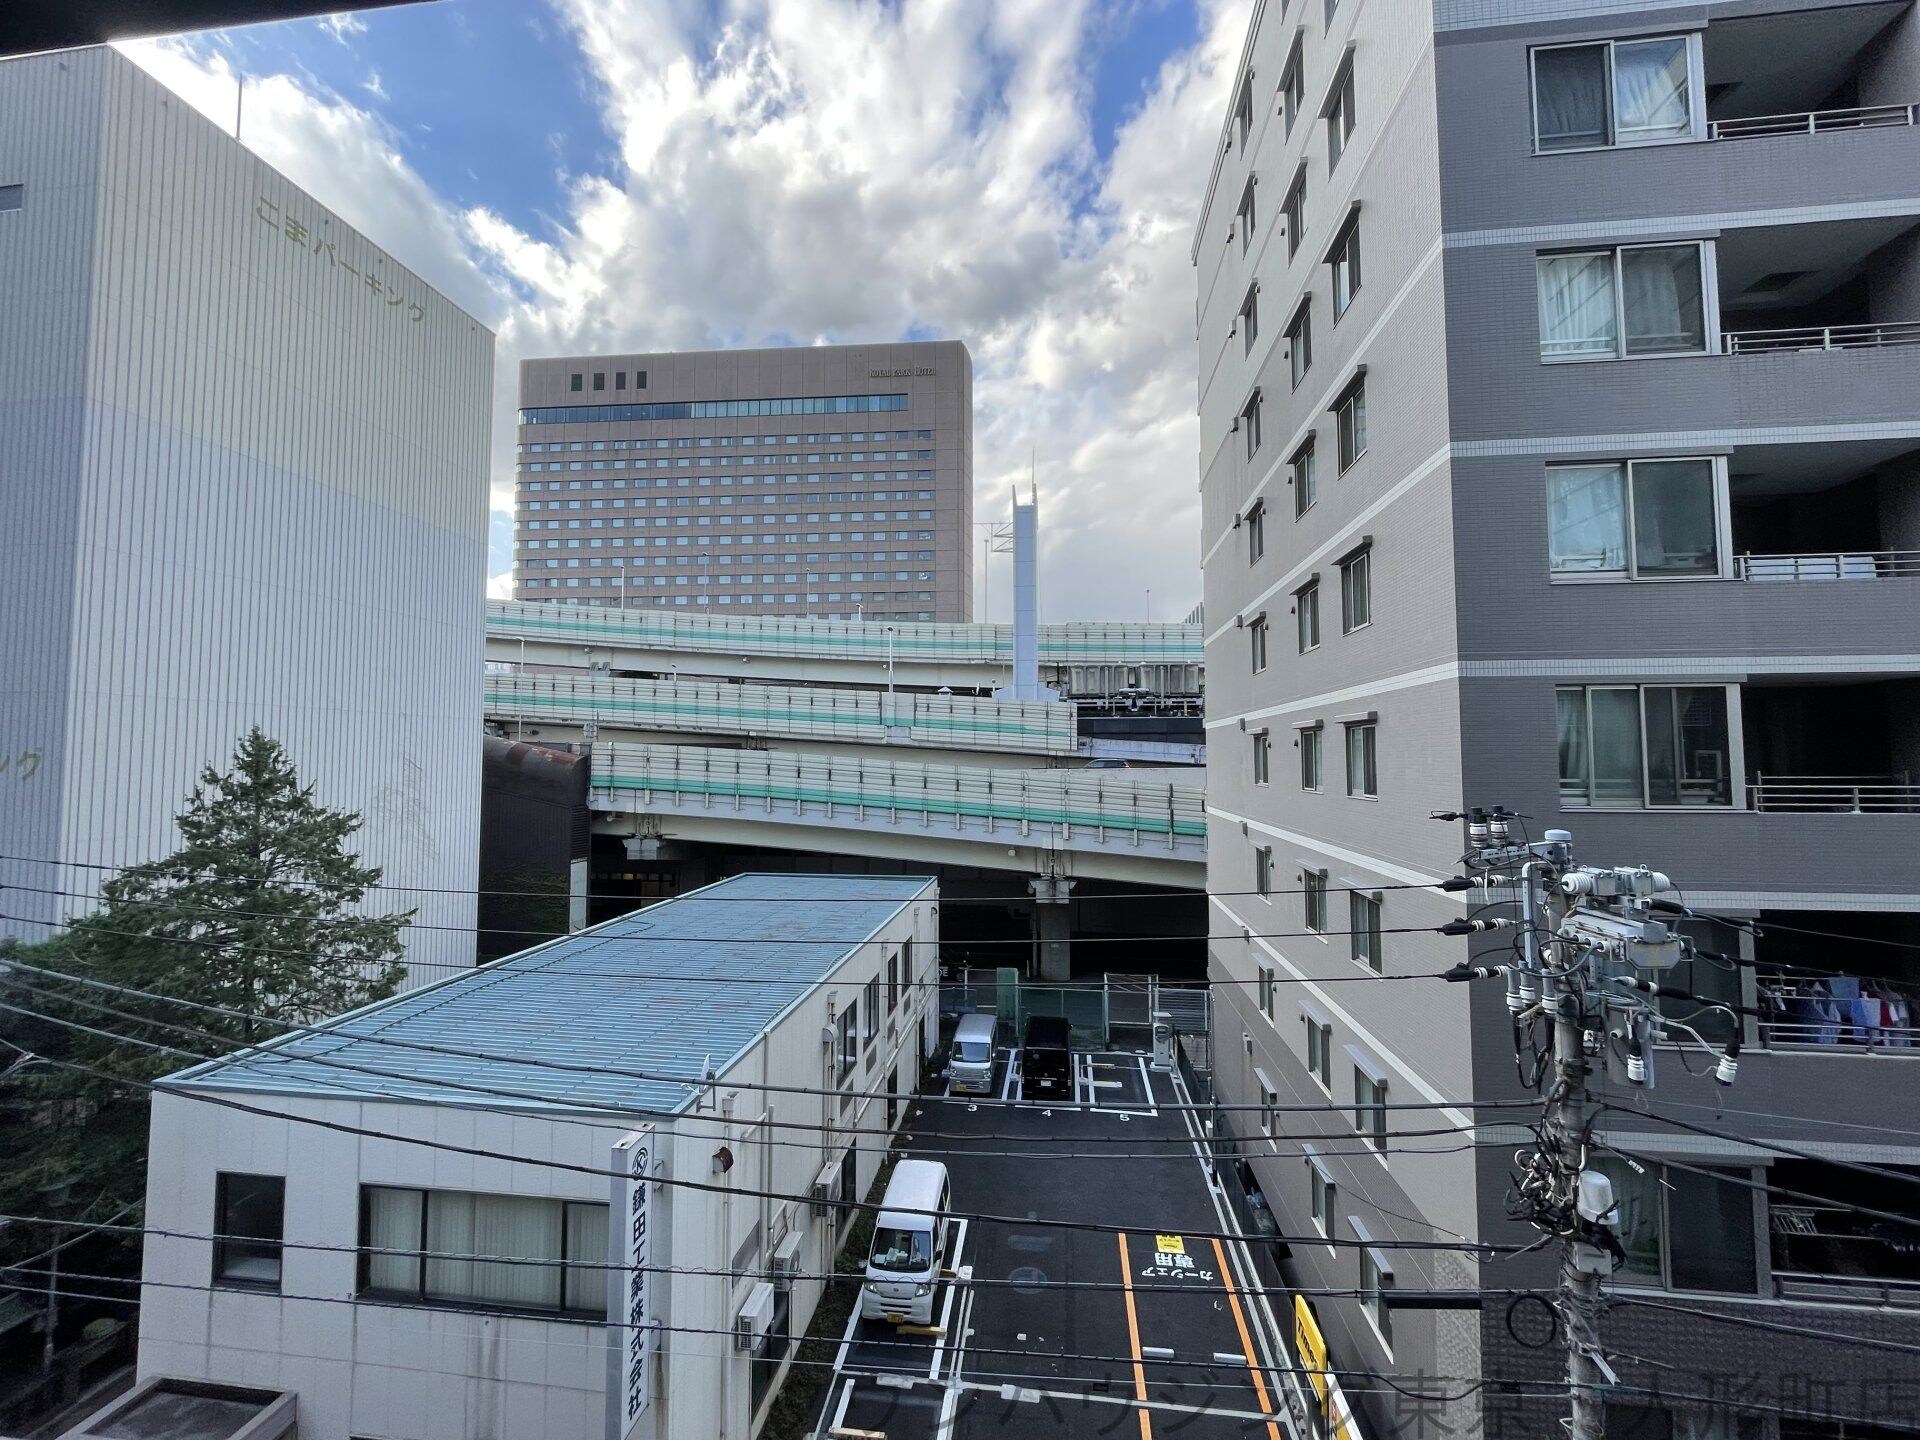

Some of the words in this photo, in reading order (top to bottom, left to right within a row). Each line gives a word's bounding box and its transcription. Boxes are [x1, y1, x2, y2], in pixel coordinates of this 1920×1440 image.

[256, 196, 426, 322] こまパーキング
[967, 1104, 977, 1112] 3
[1041, 1109, 1052, 1117] 4
[1119, 1114, 1130, 1122] 5
[1154, 1252, 1195, 1268] 専用
[1141, 1266, 1214, 1281] カーシェア
